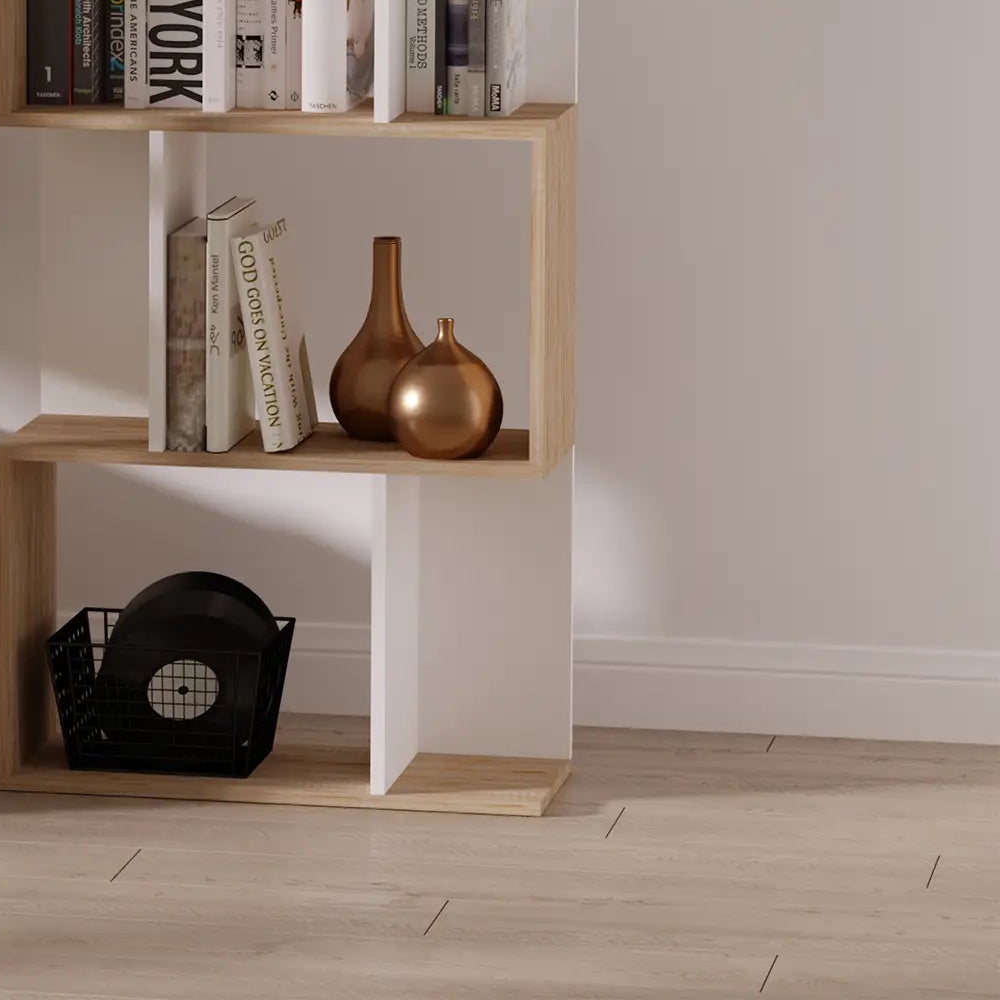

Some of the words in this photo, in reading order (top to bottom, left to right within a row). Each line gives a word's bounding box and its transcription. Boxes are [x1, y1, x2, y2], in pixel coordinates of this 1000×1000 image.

[82, 16, 92, 68] Architects
[130, 14, 138, 82] AMERICANS
[149, 4, 204, 104] YORK
[416, 7, 428, 69] METHODS
[491, 85, 500, 111] MoMA
[211, 254, 220, 291] Mantel
[237, 241, 258, 283] GOD
[211, 295, 220, 314] Ken
[247, 288, 265, 326] GOES
[253, 329, 269, 351] ON
[259, 354, 282, 427] VACATION
